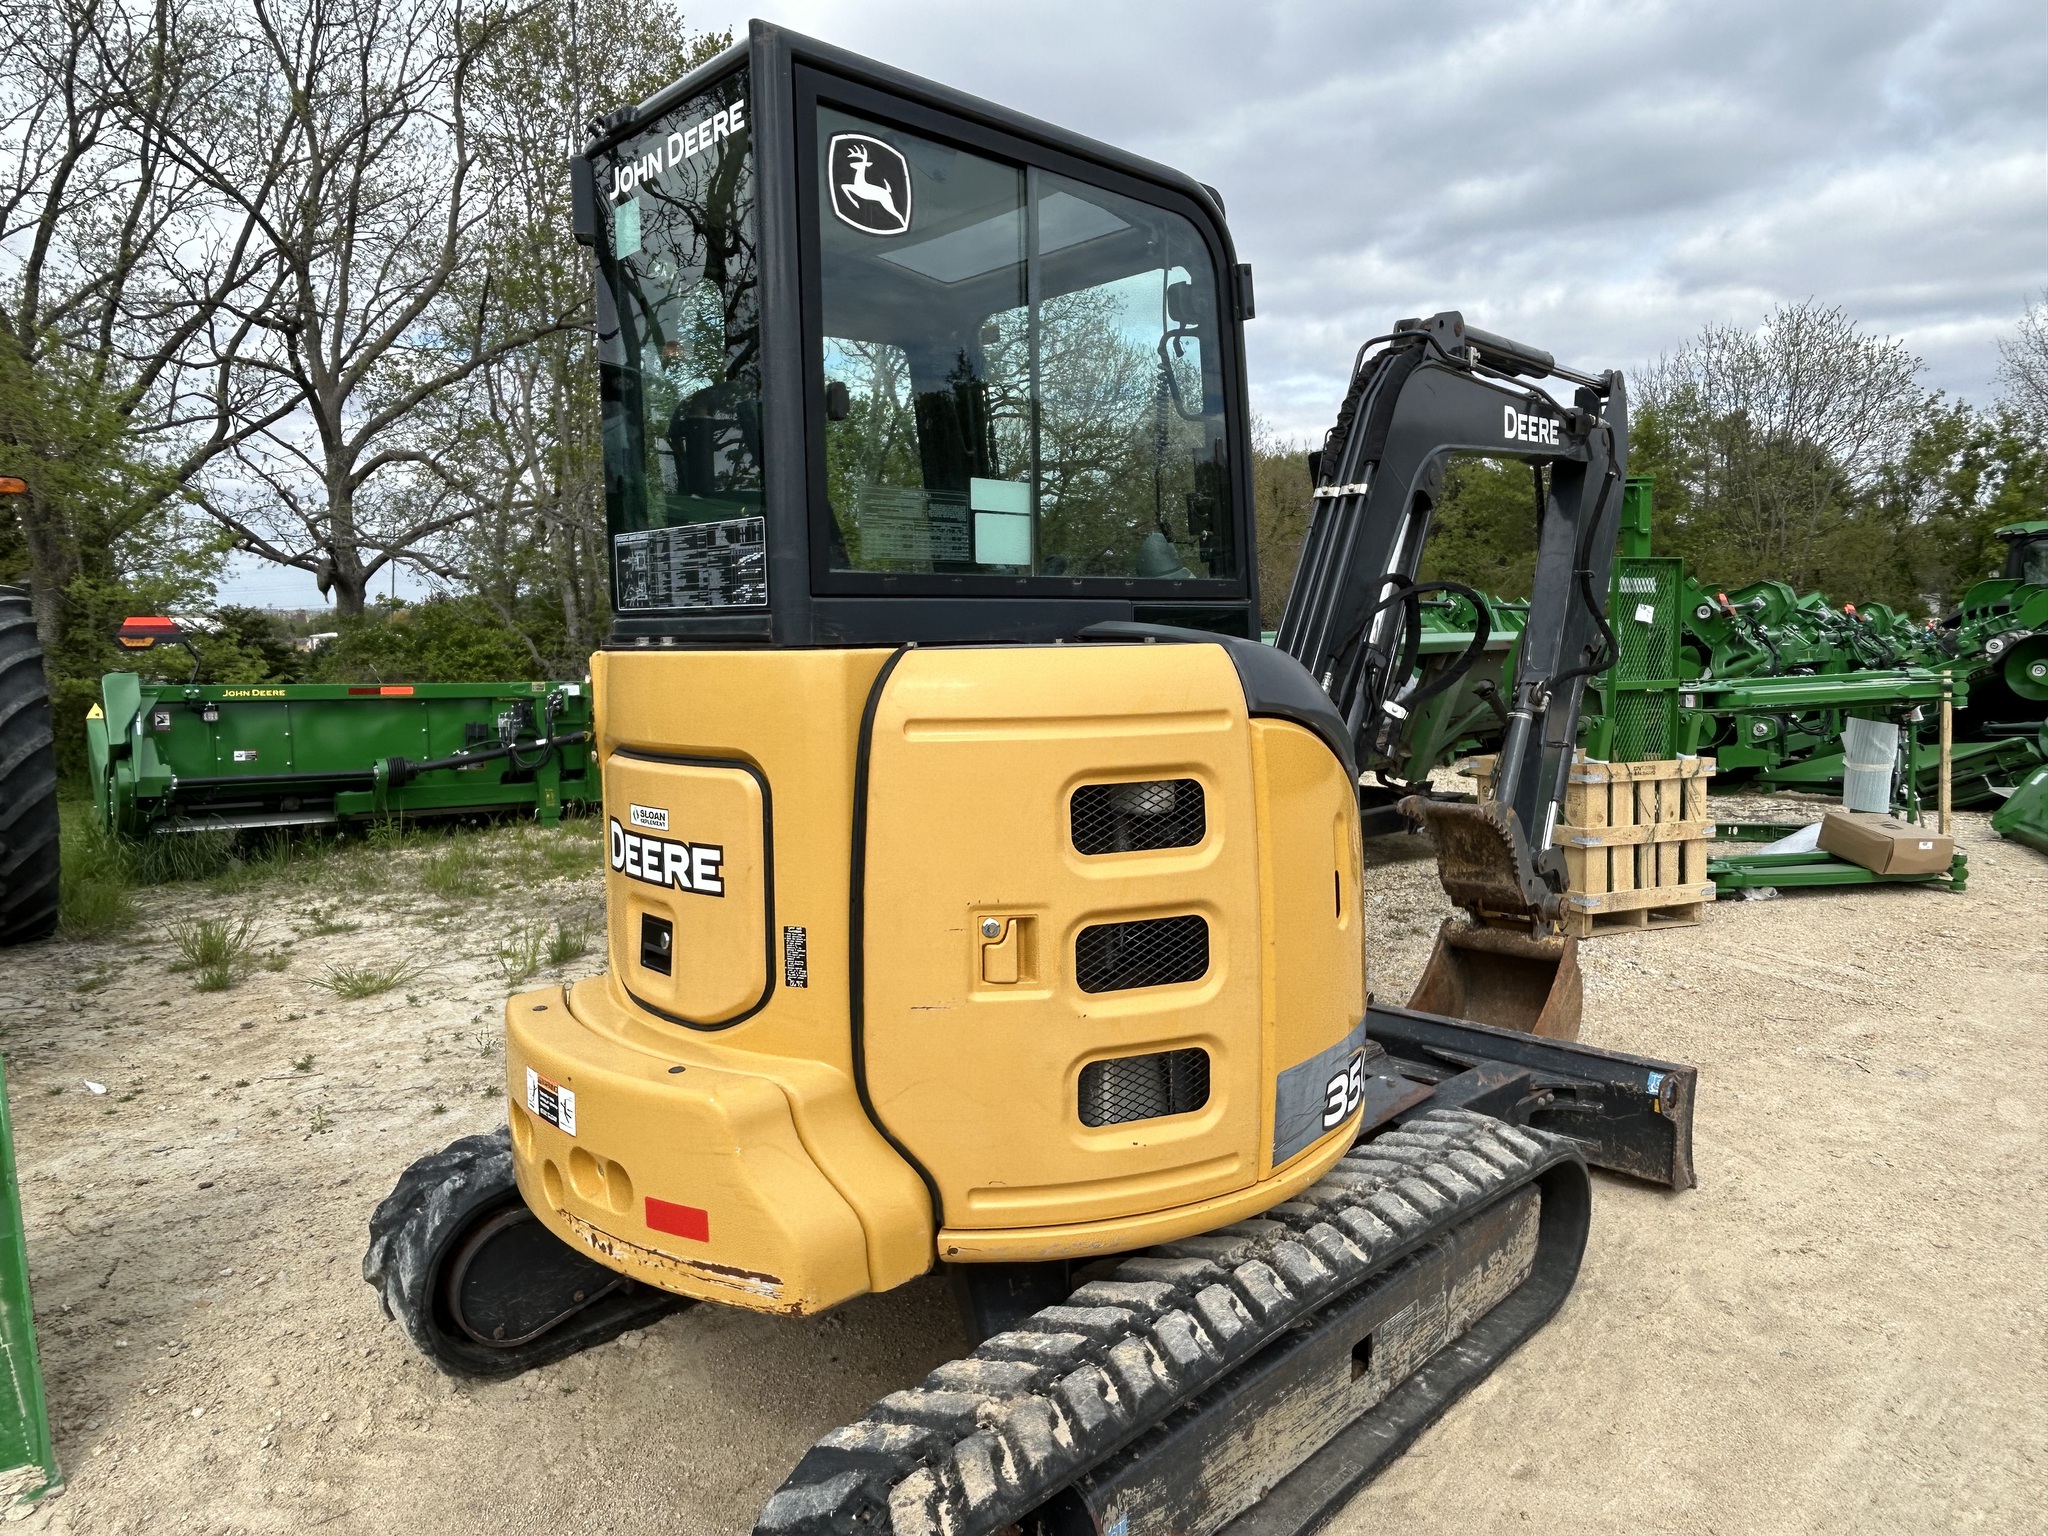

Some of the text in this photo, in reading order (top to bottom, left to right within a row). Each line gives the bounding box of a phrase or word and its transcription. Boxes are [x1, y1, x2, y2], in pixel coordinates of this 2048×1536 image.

[609, 99, 745, 201] JOHN DEERE
[1504, 405, 1560, 445] DEERE
[222, 689, 286, 697] JOHN DEERE
[640, 809, 666, 821] SLOAN
[610, 817, 723, 894] DEERE
[1322, 1046, 1366, 1131] 35
